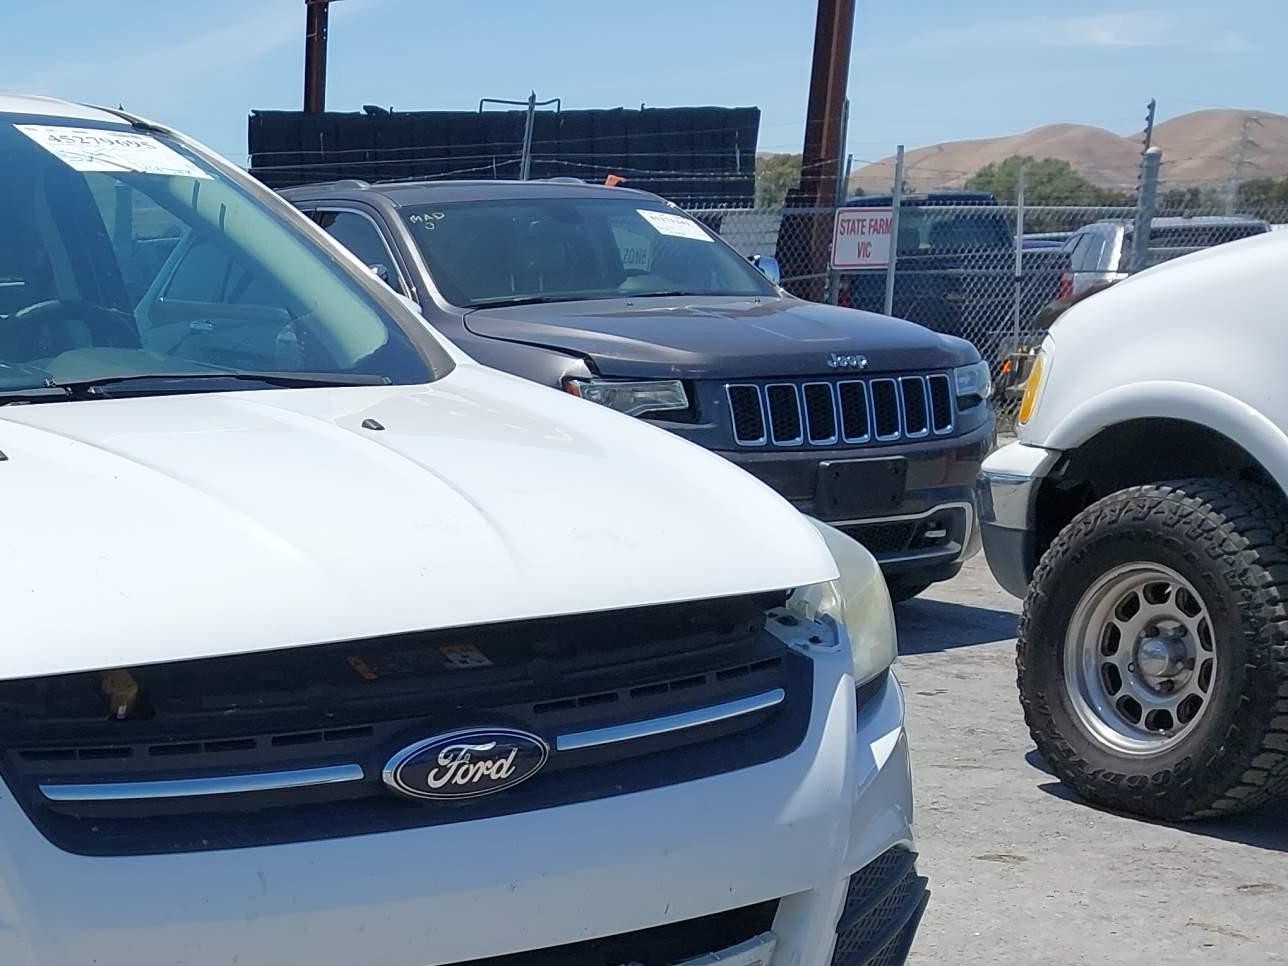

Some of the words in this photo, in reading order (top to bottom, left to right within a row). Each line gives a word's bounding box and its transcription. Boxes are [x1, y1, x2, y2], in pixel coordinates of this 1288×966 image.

[410, 212, 445, 223] MAD
[839, 219, 866, 236] STATE
[857, 241, 872, 259] VIC
[427, 741, 518, 788] Ford
